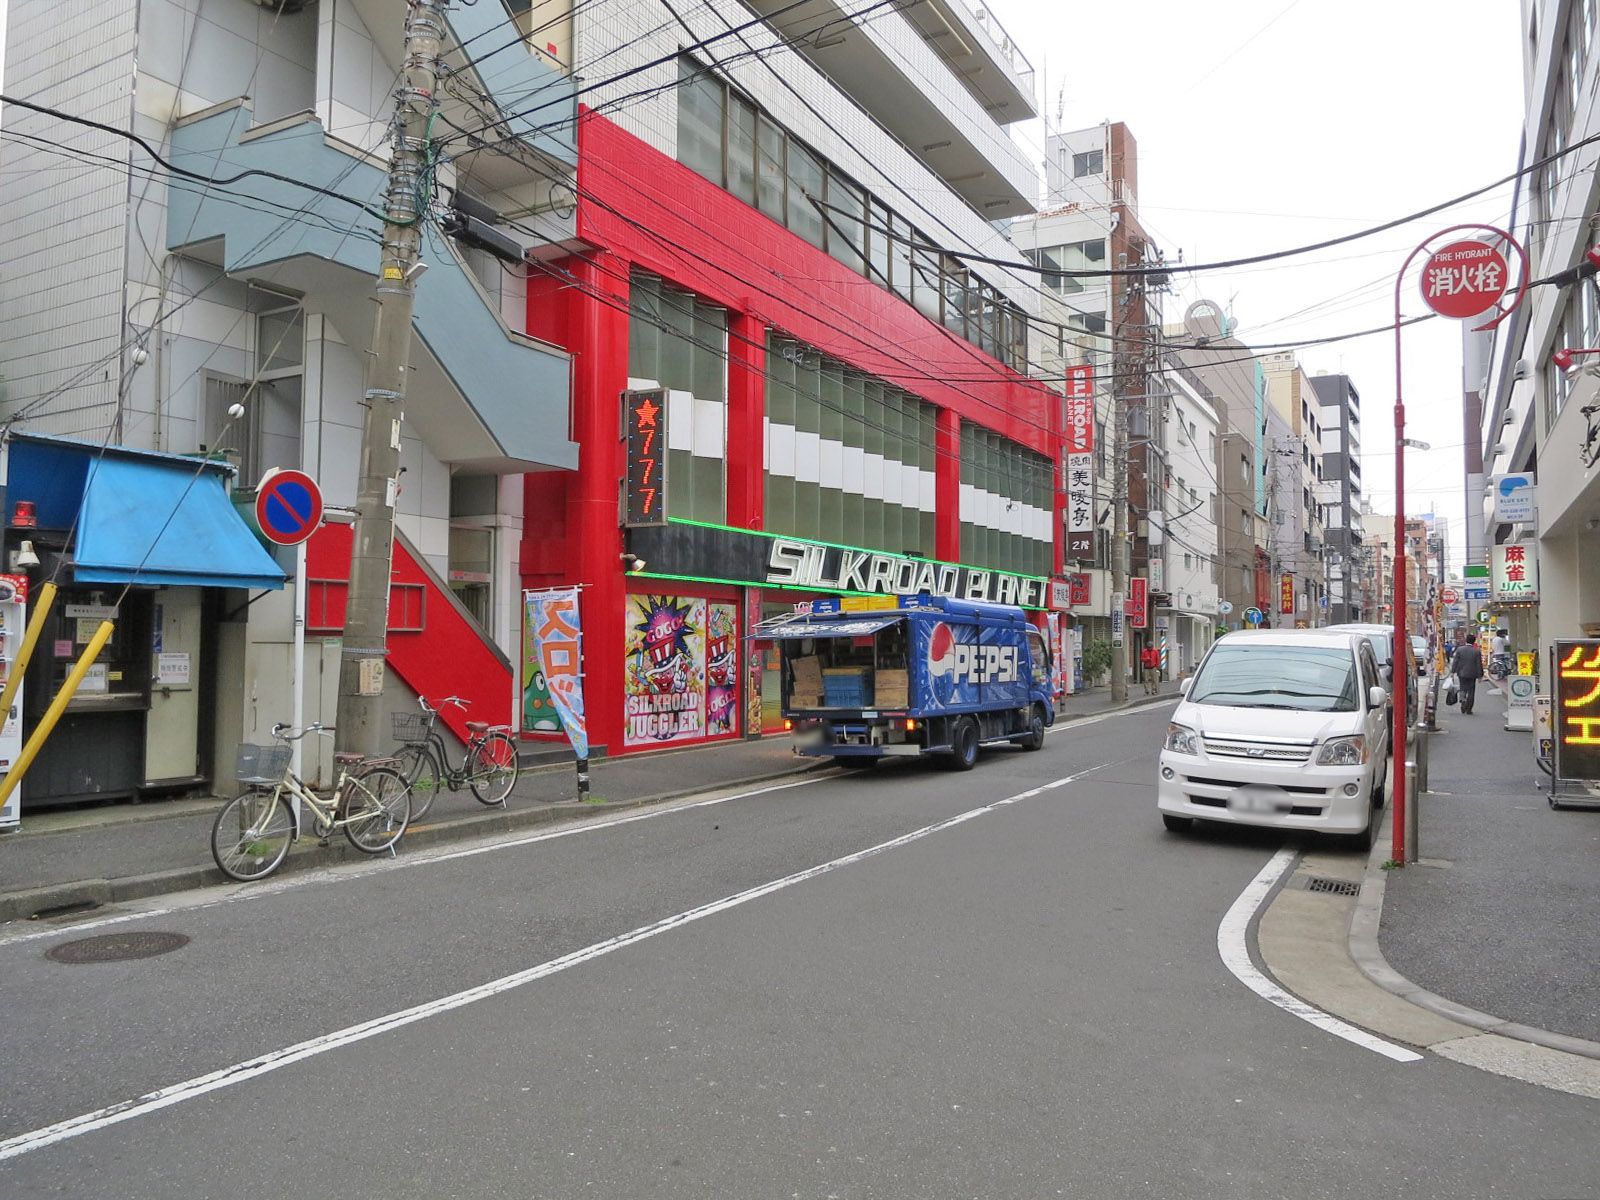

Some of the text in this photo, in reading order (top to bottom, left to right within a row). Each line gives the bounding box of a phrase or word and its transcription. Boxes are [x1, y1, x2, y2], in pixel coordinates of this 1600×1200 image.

[1435, 248, 1493, 262] FIRE HYDRANT
[1429, 261, 1502, 298] 消火栓
[1073, 369, 1087, 450] SILKROAD
[766, 538, 959, 598] SILKROAD
[1505, 546, 1525, 582] 麻雀
[1500, 582, 1531, 592] リバー
[953, 644, 1018, 684] PEPSI
[628, 692, 699, 714] SILKROAD
[628, 711, 699, 739] JUGGLER
